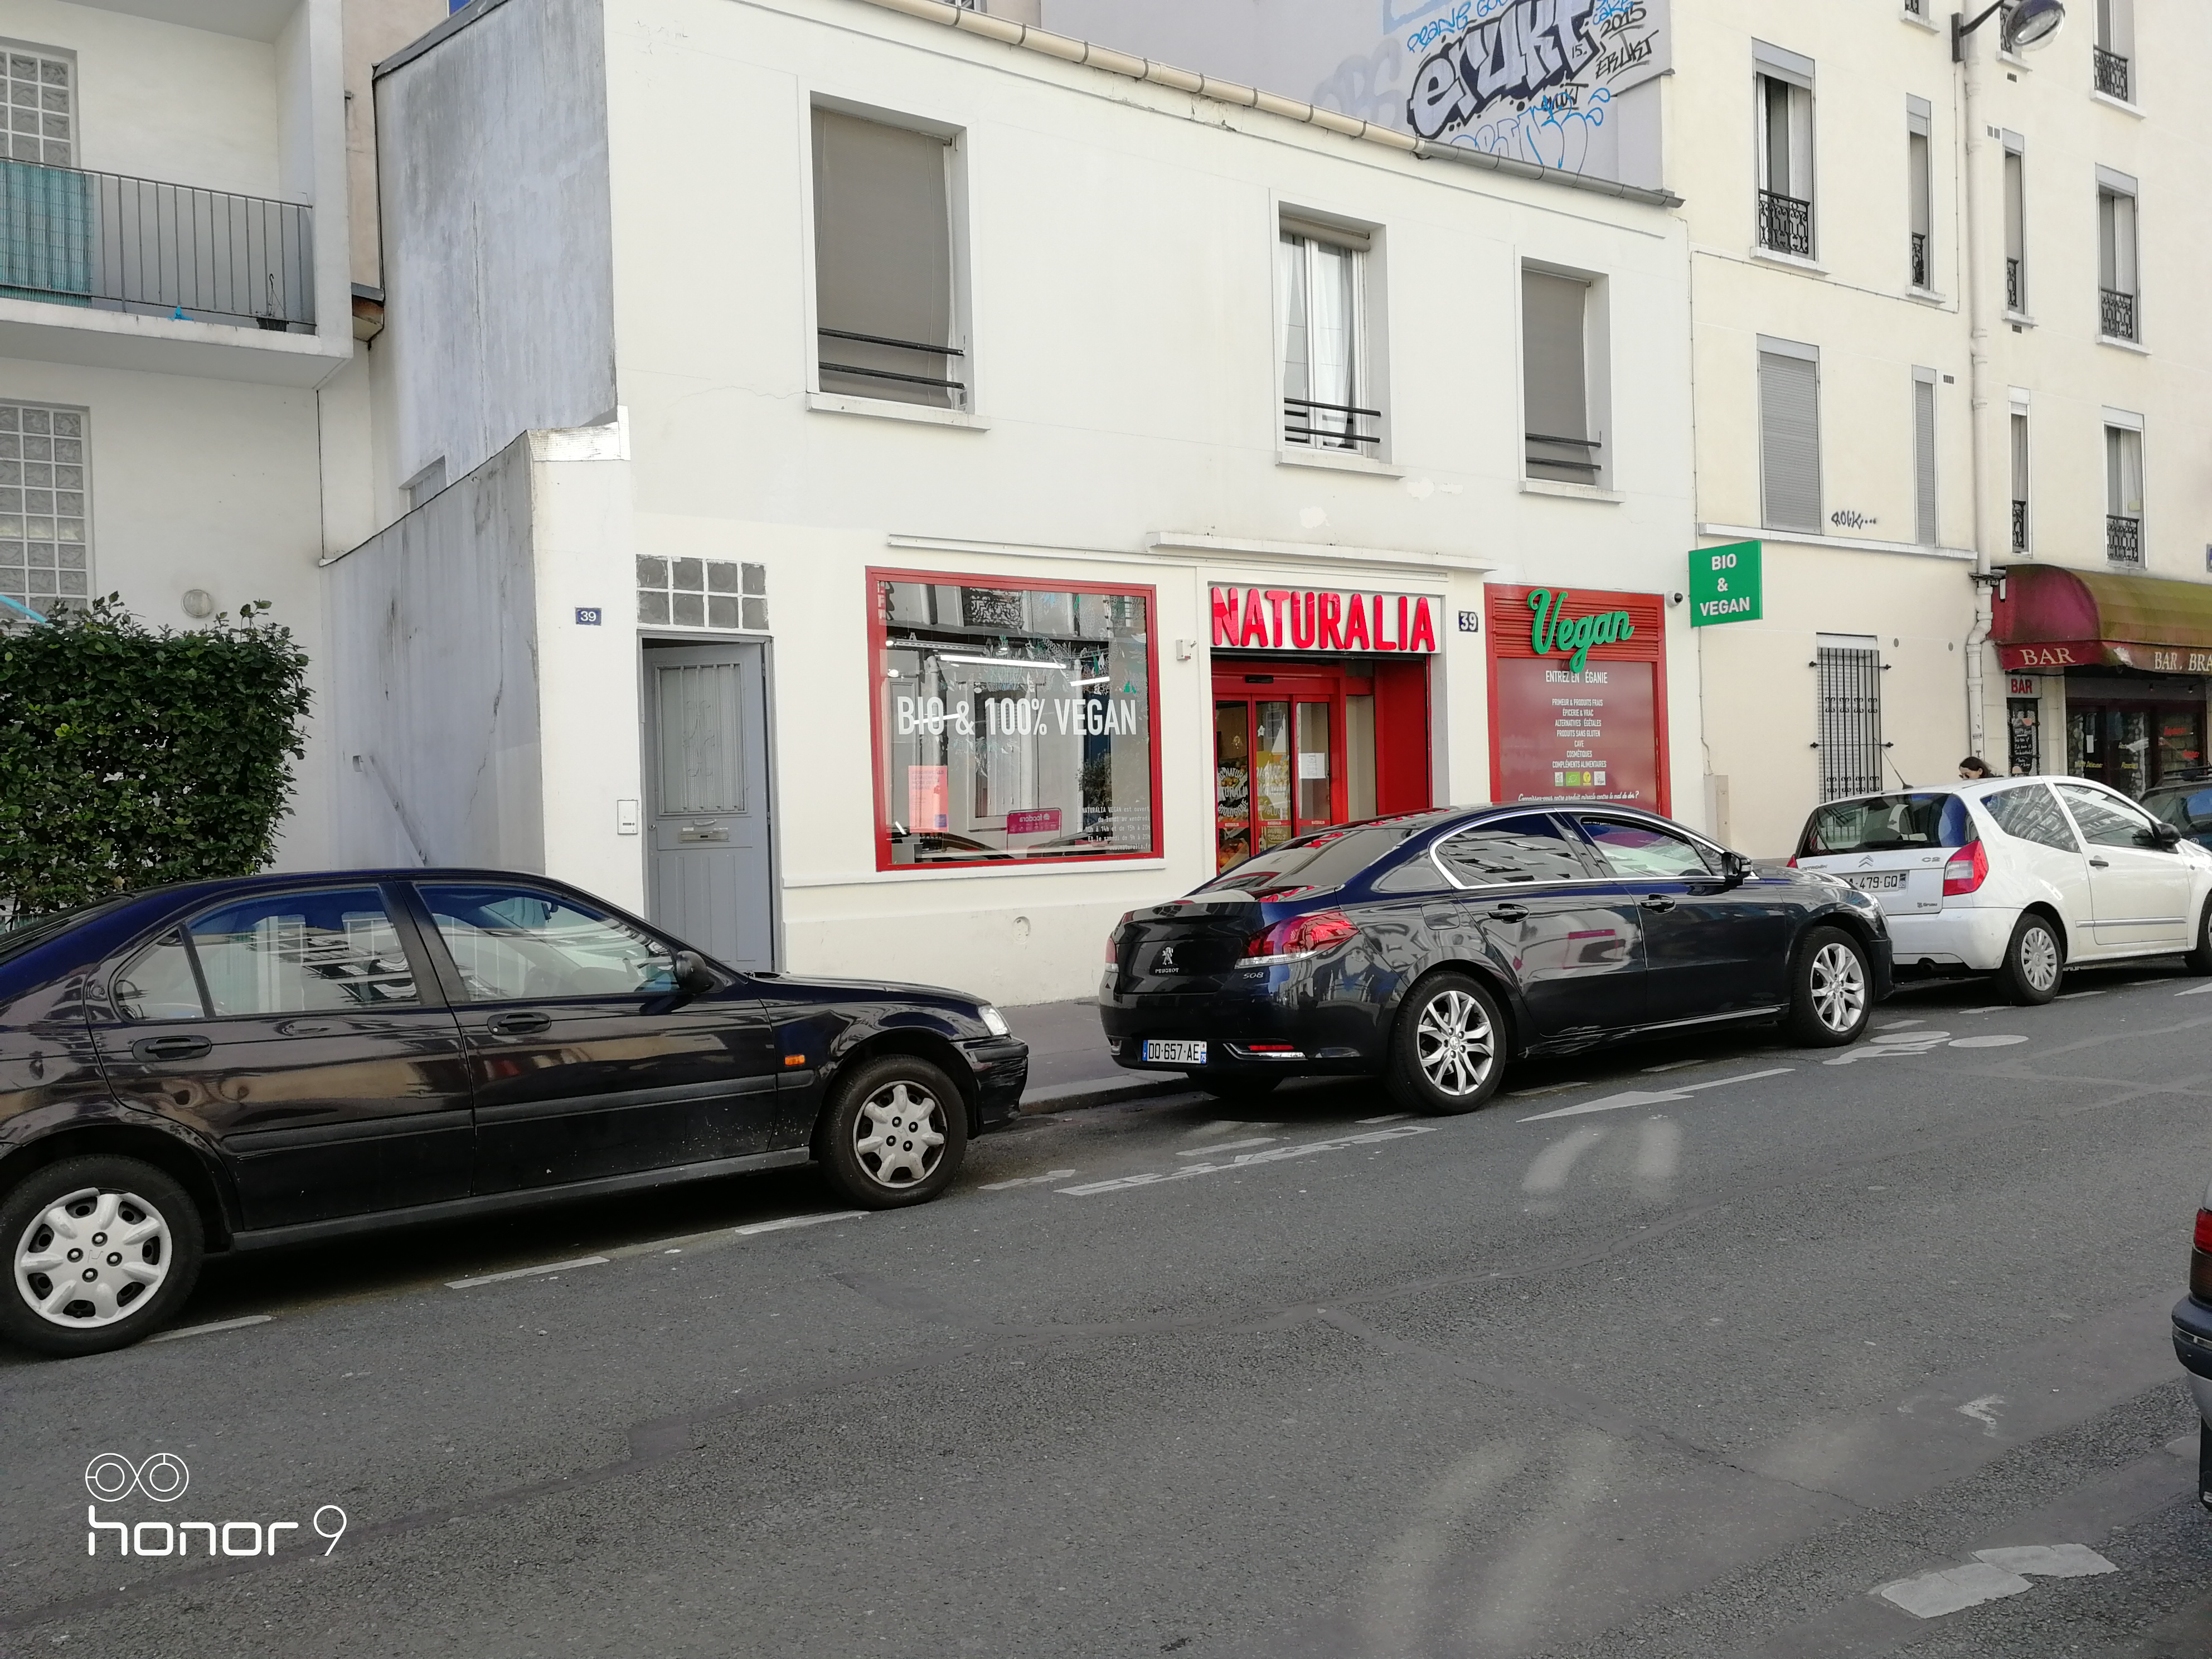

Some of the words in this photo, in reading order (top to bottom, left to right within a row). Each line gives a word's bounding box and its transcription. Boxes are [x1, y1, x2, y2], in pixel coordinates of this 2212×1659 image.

[1711, 554, 1737, 570] BIO
[1717, 578, 1728, 592] &
[1700, 596, 1750, 617] VEGAN
[580, 611, 596, 622] 39
[1212, 586, 1435, 652] NATURALIA
[1461, 612, 1477, 630] 39
[1527, 589, 1634, 673] Vegan
[2019, 648, 2076, 665] BAR
[1546, 670, 1570, 682] ENTREZ
[1571, 671, 1579, 683] EN
[2011, 678, 2032, 693] BAR
[897, 696, 944, 735] BIO
[955, 701, 974, 735] &
[984, 697, 1047, 735] 100%
[1054, 699, 1136, 735] VEGAN
[1566, 749, 1592, 758] COSMÉTIQUES
[1553, 759, 1580, 768] COMPLÉMENTS
[1845, 875, 1898, 889] -479-GQ
